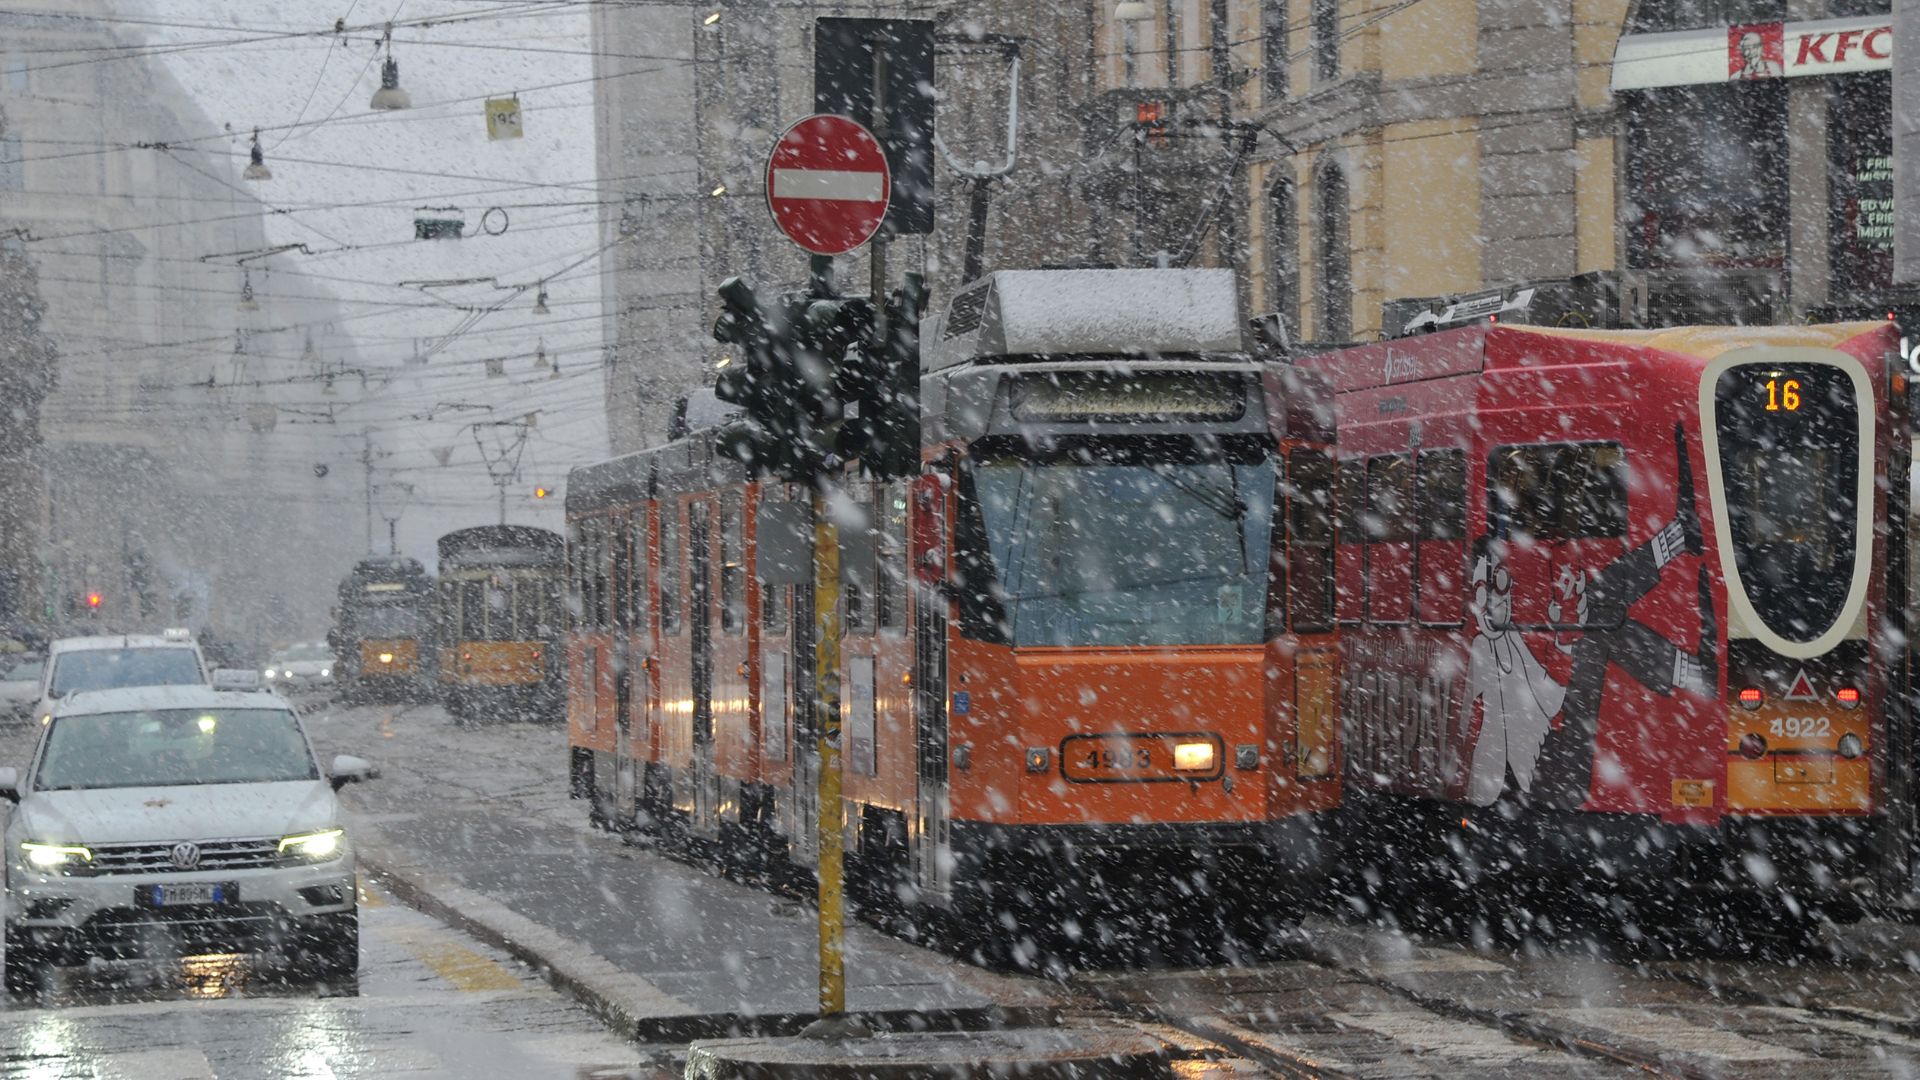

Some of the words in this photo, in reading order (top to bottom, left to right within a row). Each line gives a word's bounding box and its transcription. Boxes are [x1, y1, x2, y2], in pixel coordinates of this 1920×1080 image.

[1793, 25, 1893, 66] KFC
[1765, 380, 1800, 410] 16
[1769, 716, 1831, 737] 4922
